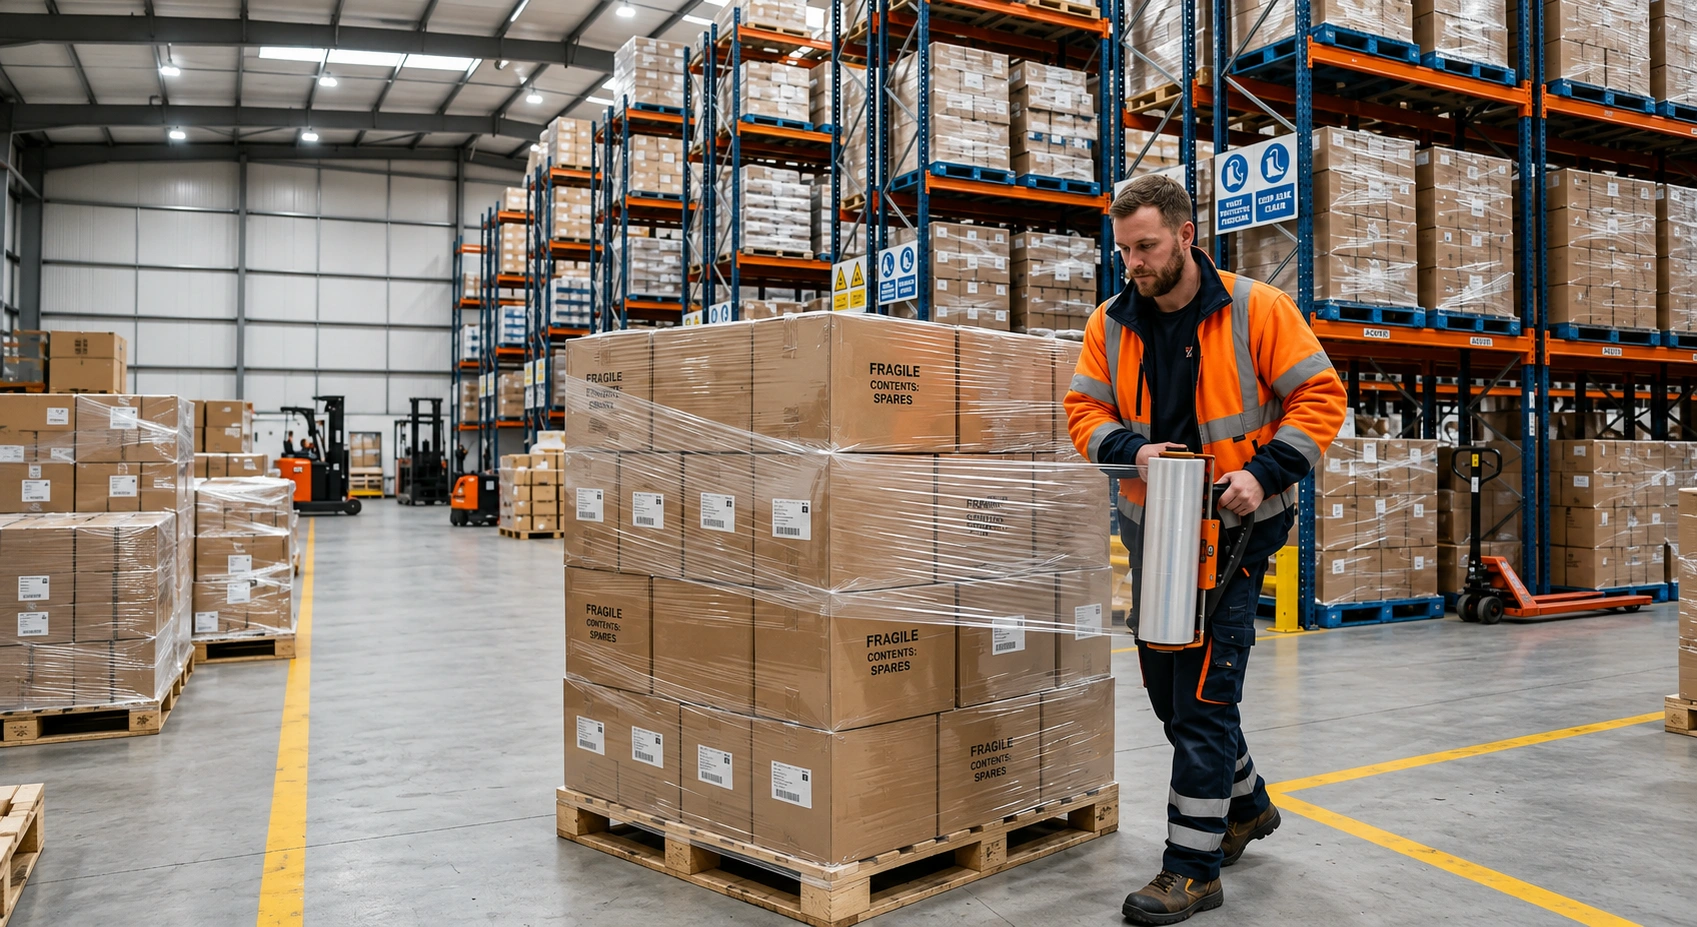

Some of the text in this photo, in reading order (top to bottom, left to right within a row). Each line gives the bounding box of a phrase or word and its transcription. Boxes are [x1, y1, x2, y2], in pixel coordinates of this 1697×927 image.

[870, 362, 920, 377] FRAGILE
[586, 372, 622, 383] FRAGILE
[870, 380, 919, 391] CONTENTS:
[873, 393, 912, 405] SPARES
[586, 604, 622, 619] FRAGILE
[590, 630, 617, 643] SPARES
[867, 629, 918, 648] FRAGILE
[867, 647, 917, 662] CONTENTS:
[871, 660, 911, 676] SPARES
[970, 737, 1013, 757] FRAGILE
[974, 766, 1007, 782] SPARES
